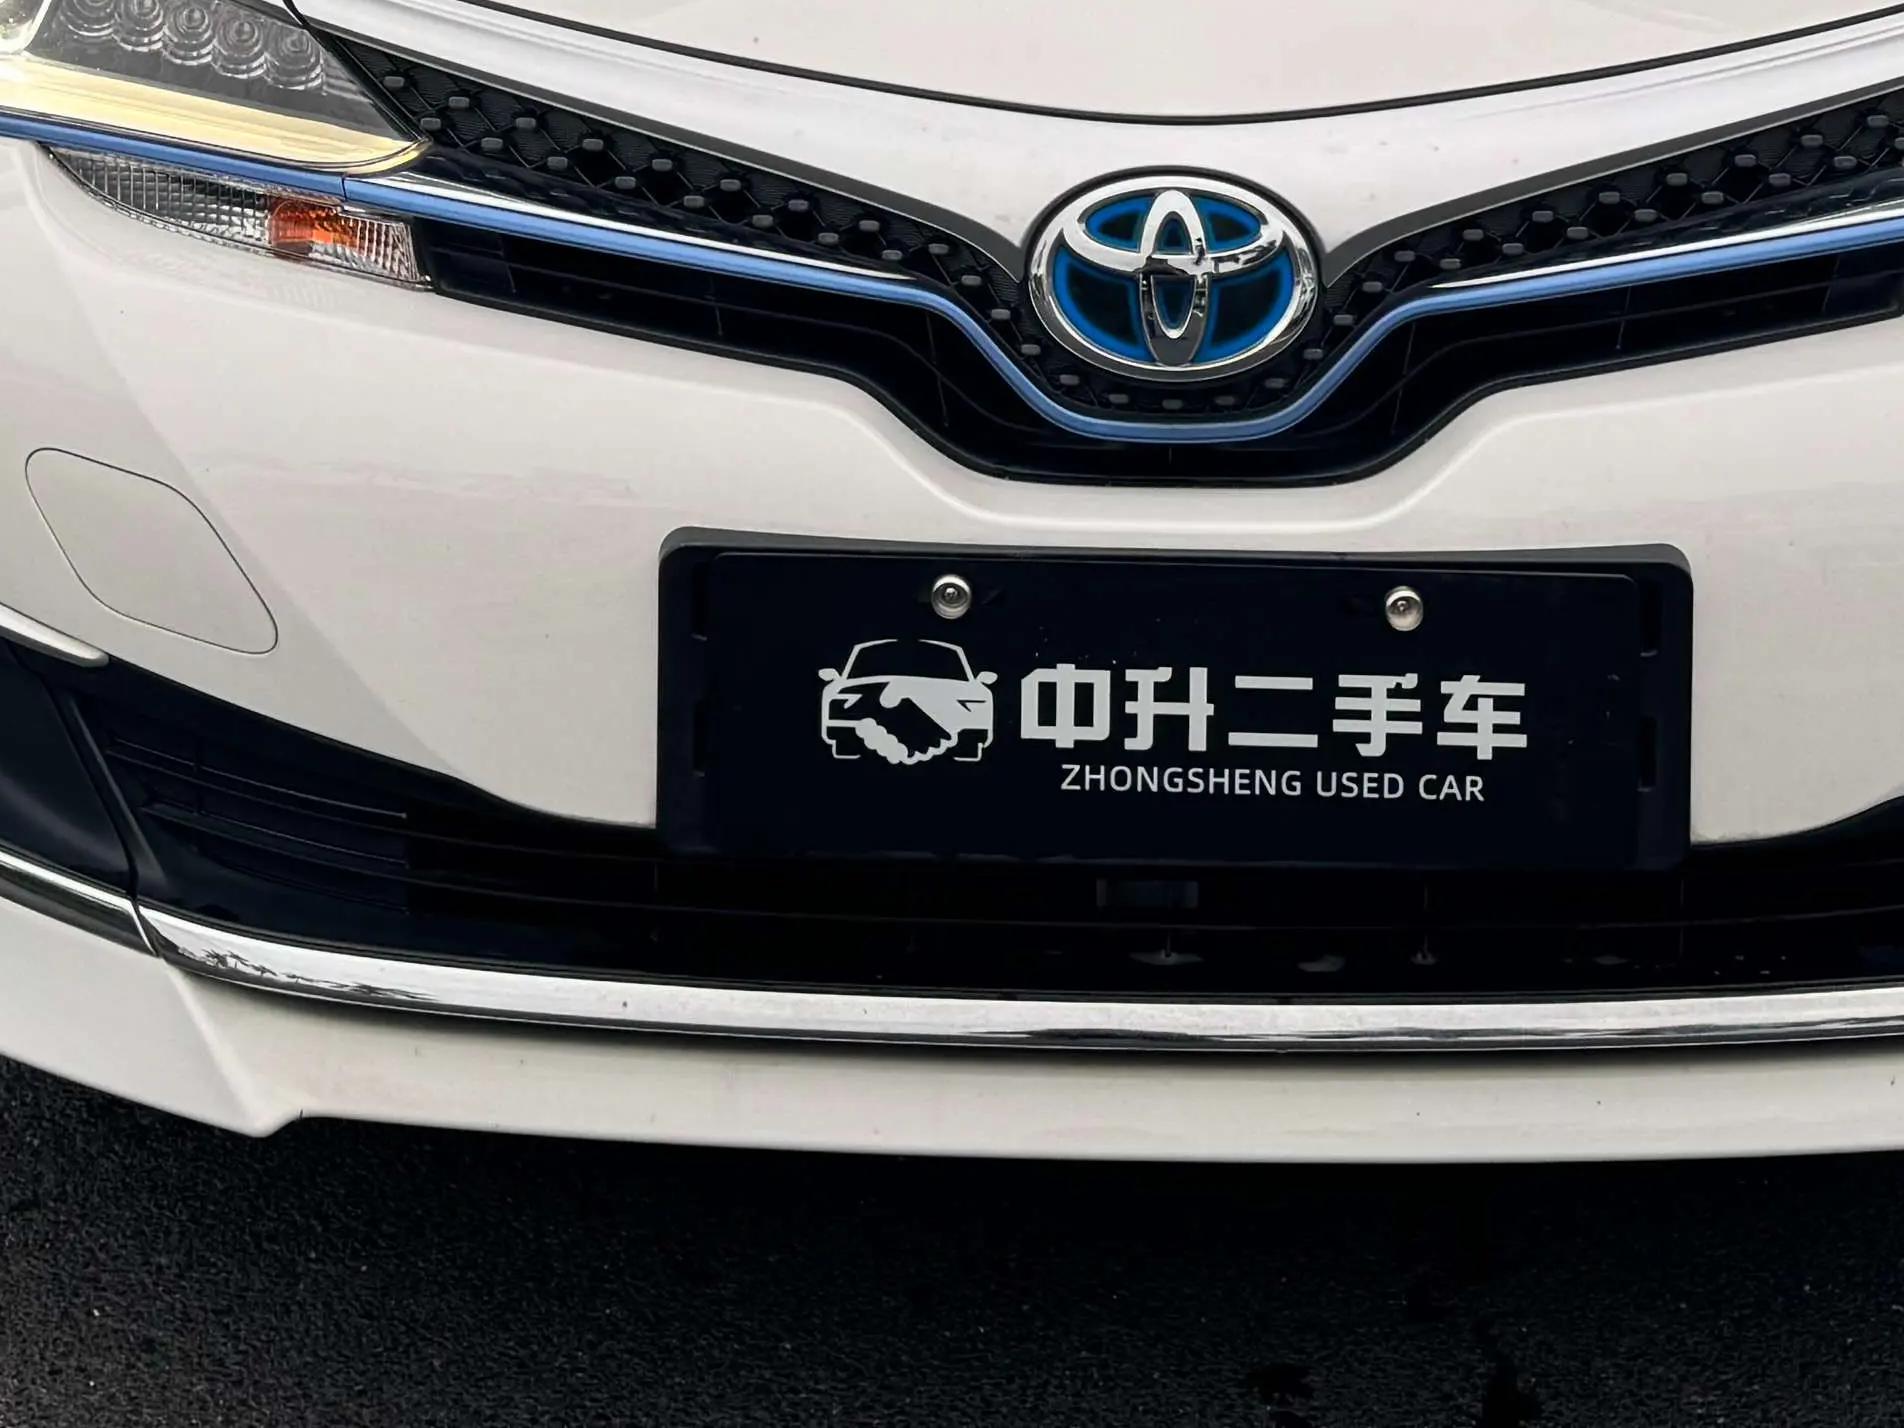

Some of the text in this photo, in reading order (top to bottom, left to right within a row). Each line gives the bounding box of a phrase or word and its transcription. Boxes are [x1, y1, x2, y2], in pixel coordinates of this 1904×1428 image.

[1020, 663, 1528, 760] 中升二手车
[1060, 763, 1485, 803] ZHONGSHENG USED CAR
